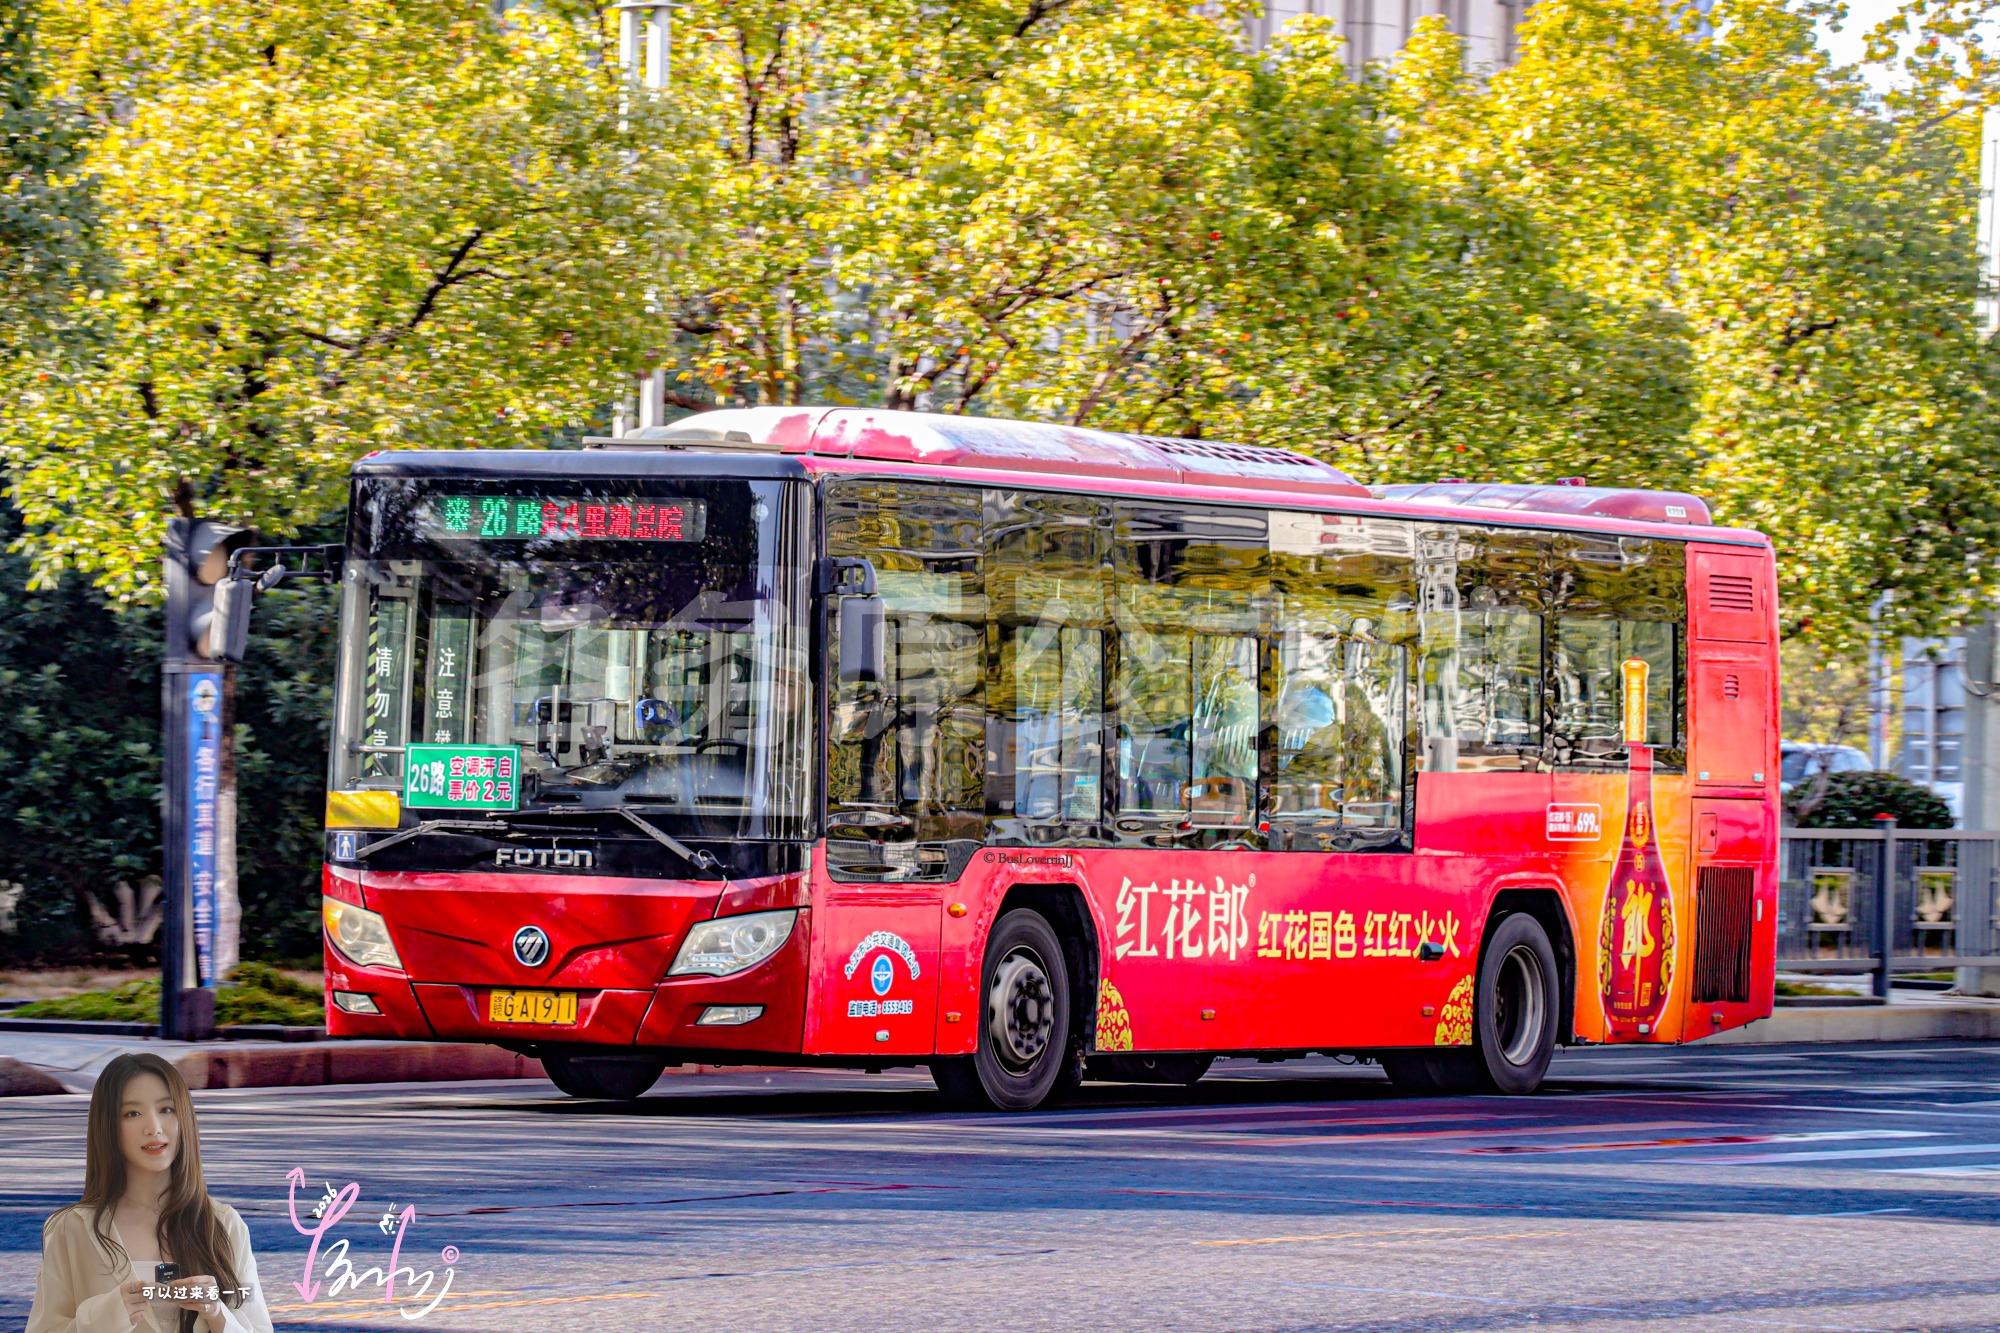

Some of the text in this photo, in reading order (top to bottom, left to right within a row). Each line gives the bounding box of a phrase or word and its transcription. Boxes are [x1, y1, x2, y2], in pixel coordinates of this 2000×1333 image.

[409, 760, 446, 796] 26路
[449, 756, 513, 778] 空调开启
[447, 780, 512, 802] 票价2元
[495, 847, 593, 868] FOTON
[1115, 874, 1249, 962] 红花郎
[1257, 909, 1461, 960] 红花国色 红红火火
[844, 931, 921, 980] 九江市公共交通集团公司
